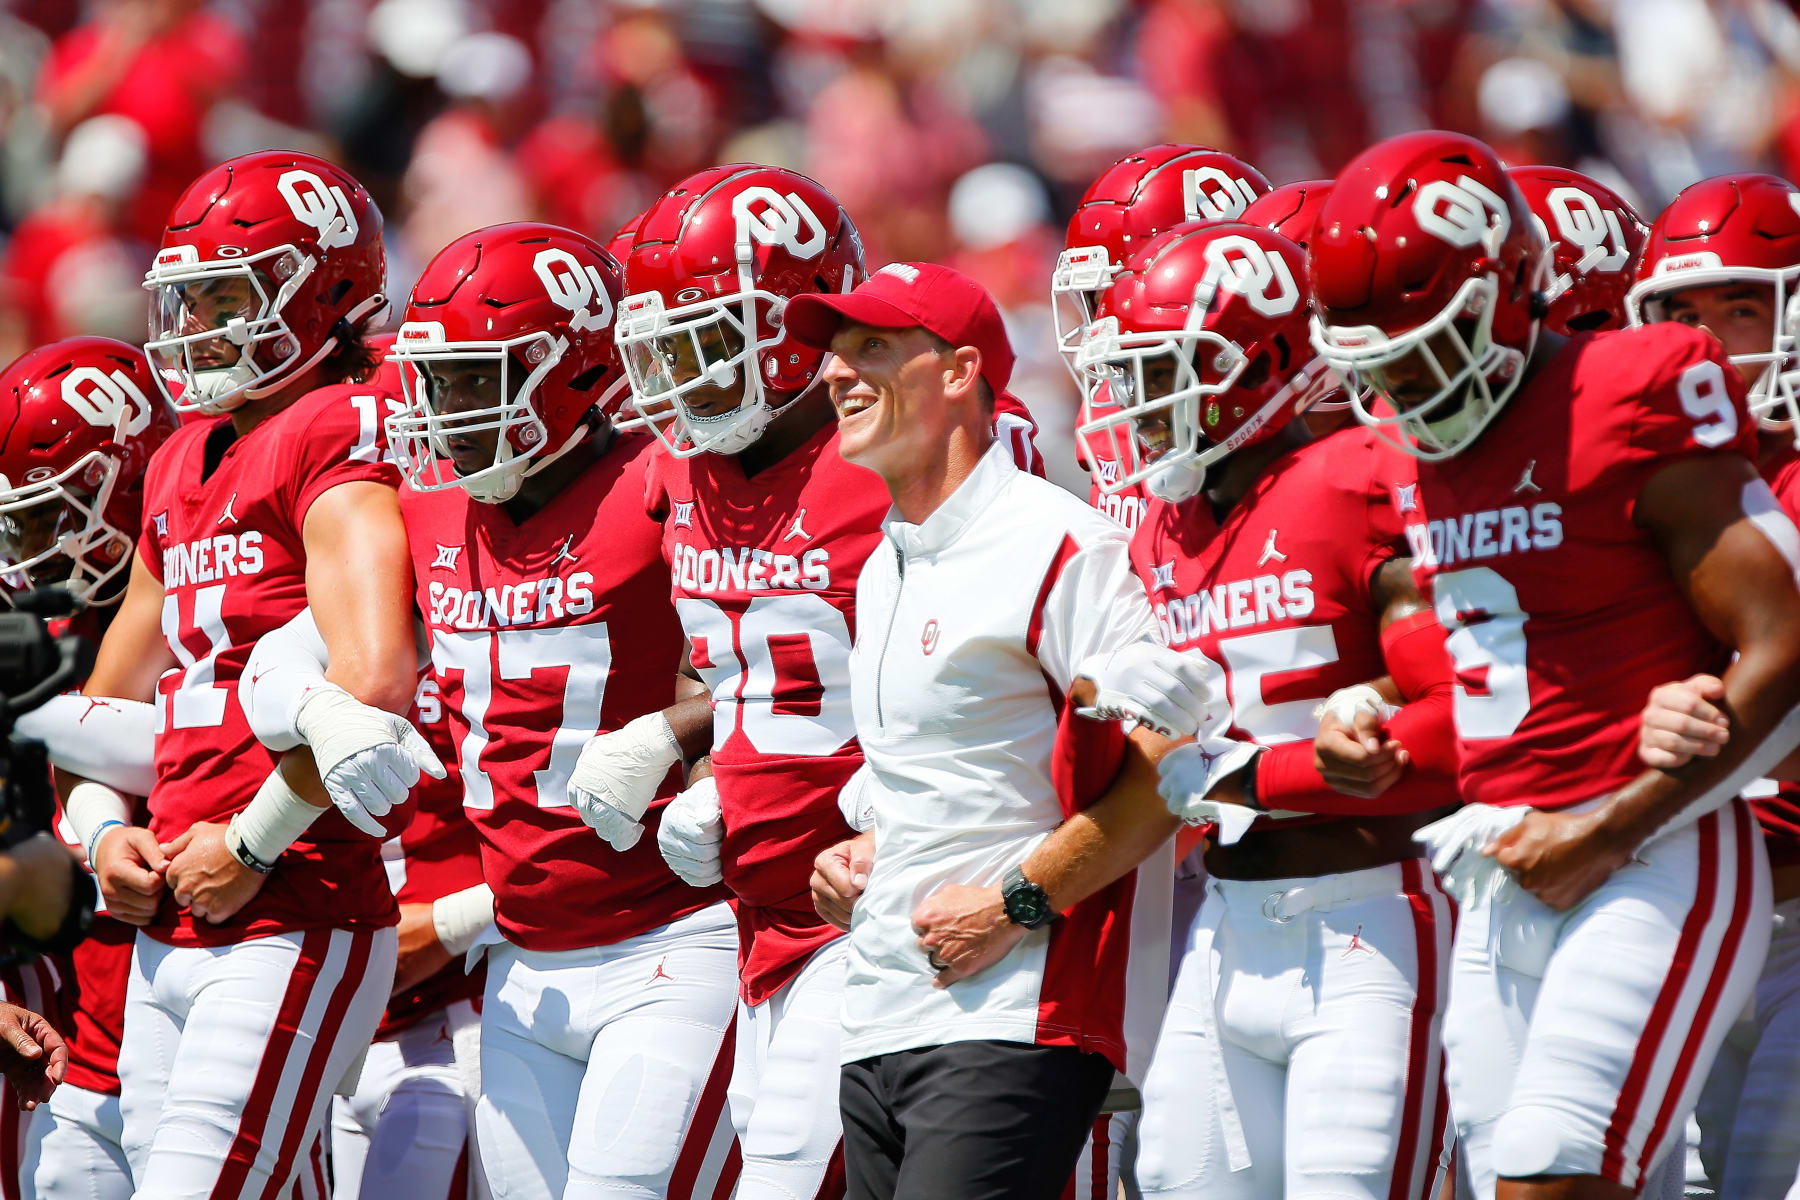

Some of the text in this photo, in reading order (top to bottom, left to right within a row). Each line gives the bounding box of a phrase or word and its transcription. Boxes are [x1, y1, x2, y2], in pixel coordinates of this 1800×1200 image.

[277, 169, 359, 247] OU
[733, 185, 828, 260] OU
[1411, 175, 1511, 248] OU
[1547, 187, 1631, 271] OU
[532, 248, 614, 332] OU
[1203, 235, 1300, 316] OU
[61, 366, 152, 436] OU
[1678, 360, 1738, 448] 9
[428, 571, 594, 630] SOONERS
[673, 542, 831, 593] SOONERS
[1432, 566, 1531, 739] 9
[430, 621, 612, 811] 77
